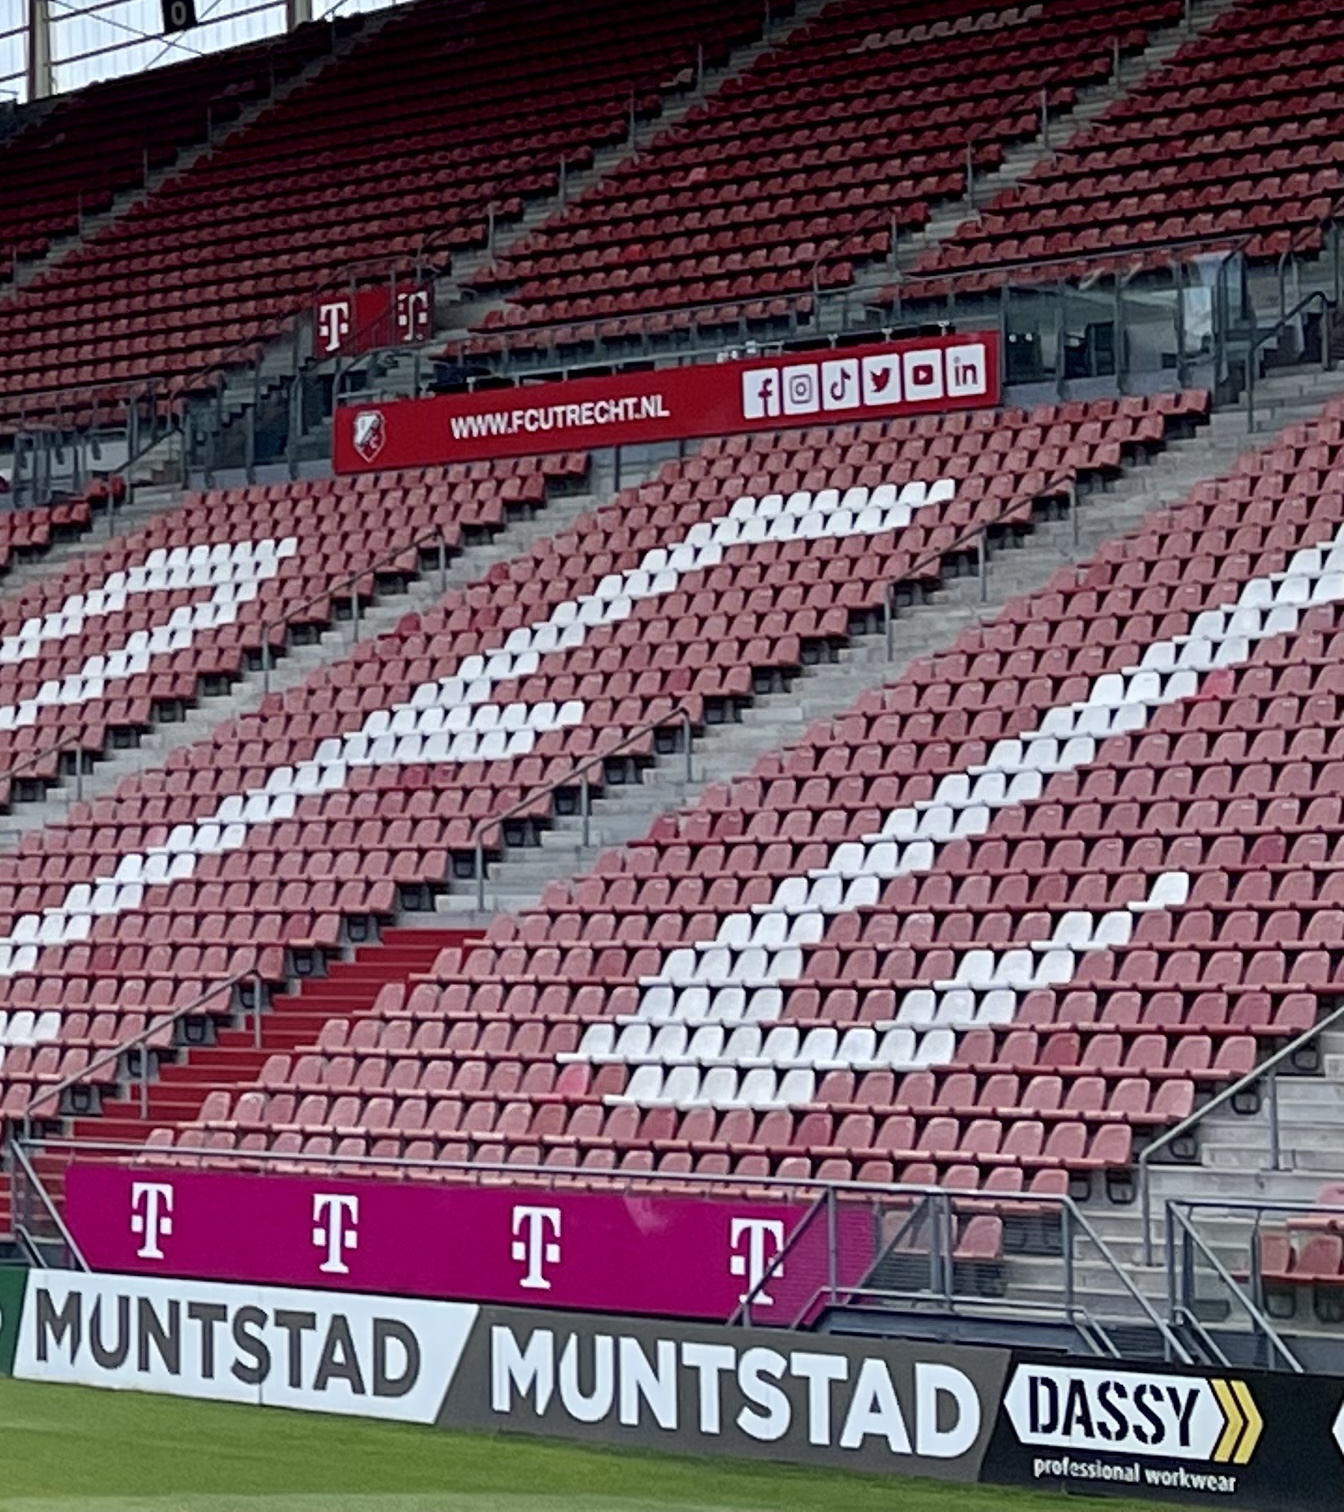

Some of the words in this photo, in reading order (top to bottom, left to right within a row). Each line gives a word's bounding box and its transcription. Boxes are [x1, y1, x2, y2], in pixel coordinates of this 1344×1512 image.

[450, 392, 671, 440] WWW.FCUTRECHT.NL
[34, 1288, 421, 1399] MUNTSTAD
[491, 1325, 981, 1458] MUNTSTAD
[1028, 1375, 1201, 1447] DASSY
[1033, 1456, 1141, 1483] professional
[1144, 1466, 1237, 1493] workwear
